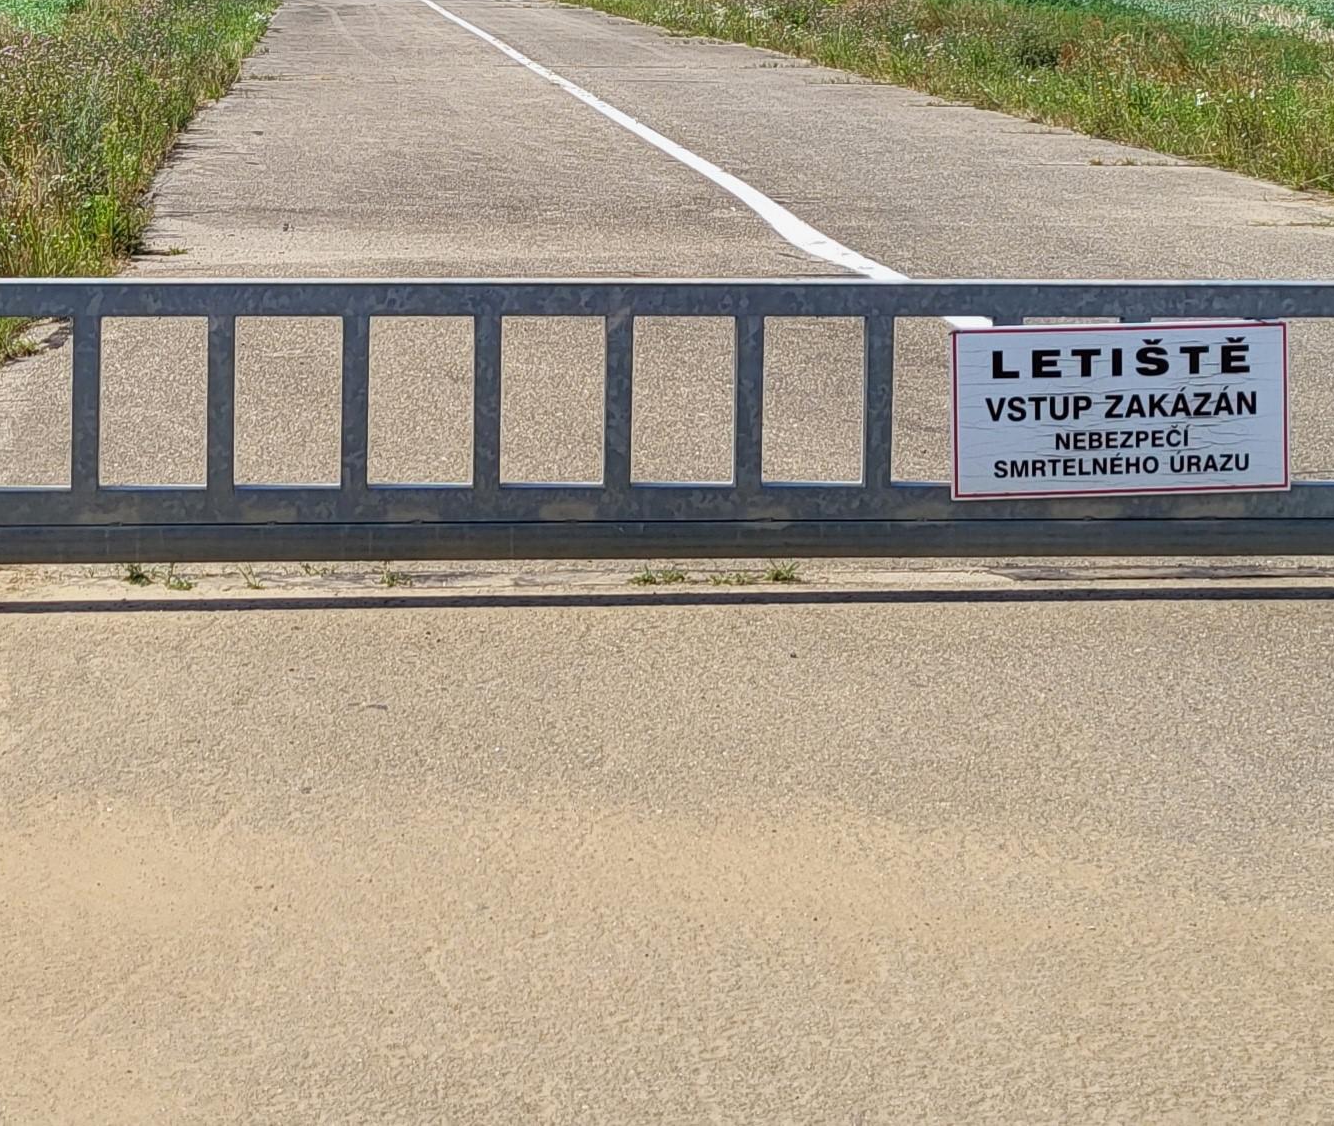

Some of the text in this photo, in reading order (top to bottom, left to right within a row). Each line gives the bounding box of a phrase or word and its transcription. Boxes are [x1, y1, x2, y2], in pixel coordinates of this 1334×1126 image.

[991, 337, 1251, 379] LETIŠTĚ
[985, 386, 1257, 422] VSTUP ZAKÁZÁN
[1055, 424, 1189, 451] NEBEZPEČÍ
[993, 450, 1250, 478] SMRTELNÉHO ÚRAZU
